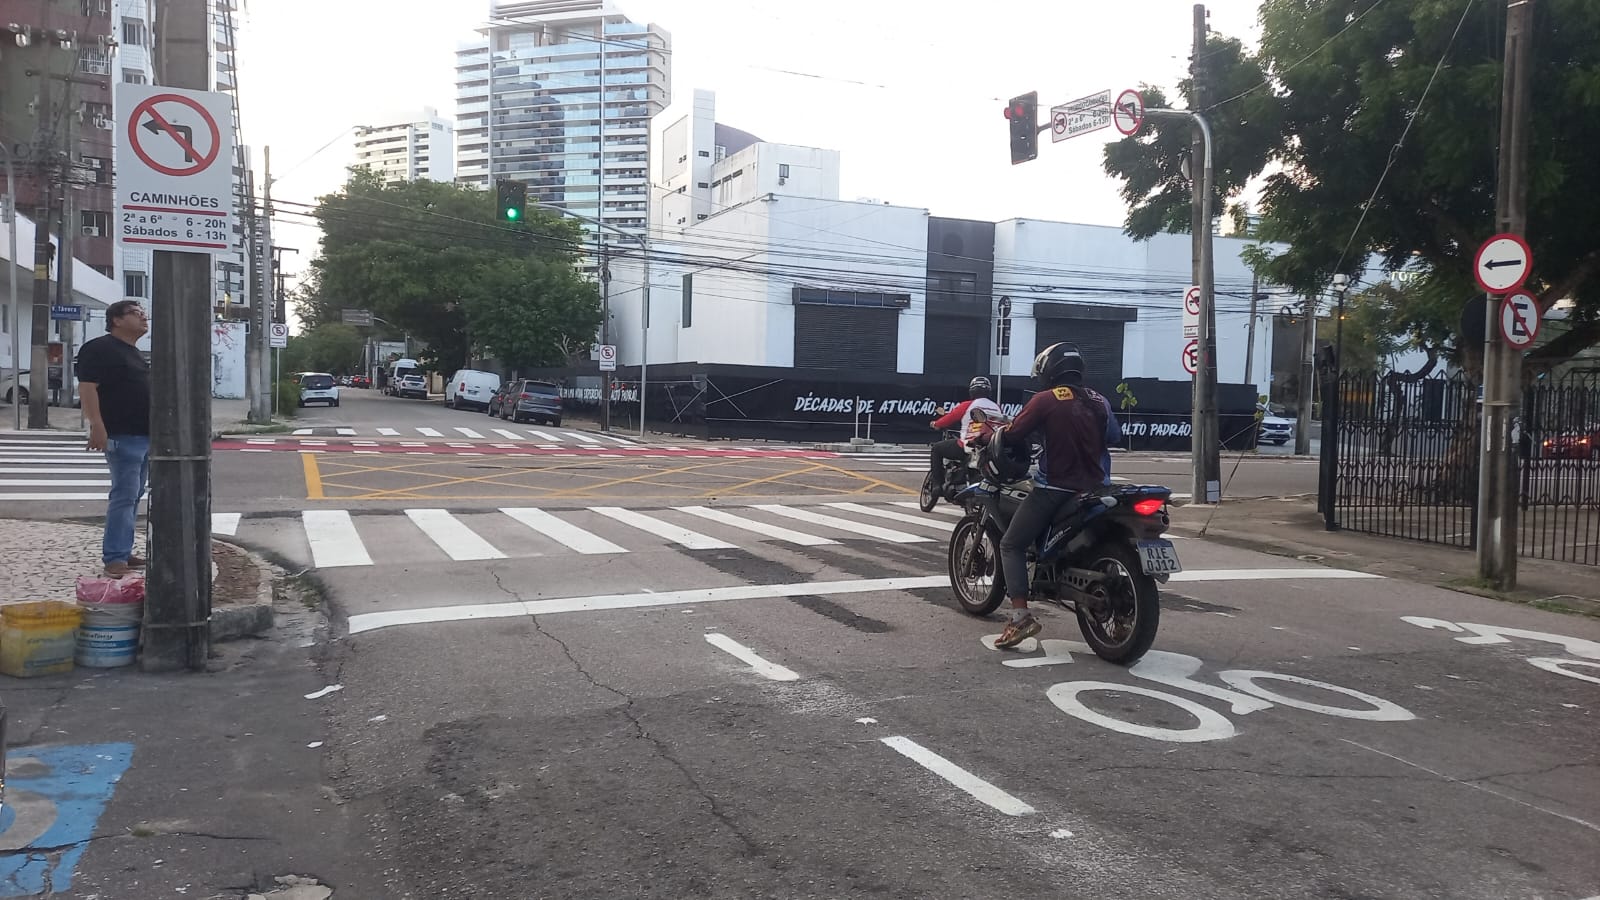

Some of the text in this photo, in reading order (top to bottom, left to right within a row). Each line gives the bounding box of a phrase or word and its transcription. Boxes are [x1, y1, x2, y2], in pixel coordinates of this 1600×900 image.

[130, 192, 219, 208] CAMINHÕES
[123, 213, 136, 222] 2ª
[150, 215, 162, 224] 6ª
[204, 219, 226, 229] 20h
[123, 225, 178, 237] Sábados
[205, 231, 226, 240] 13h
[794, 392, 853, 413] DÉCADAS
[857, 399, 874, 414] DE
[878, 397, 937, 416] ATUAÇÃO,
[1121, 421, 1193, 437] ALTO PADRÃO.
[1147, 548, 1169, 560] RIE
